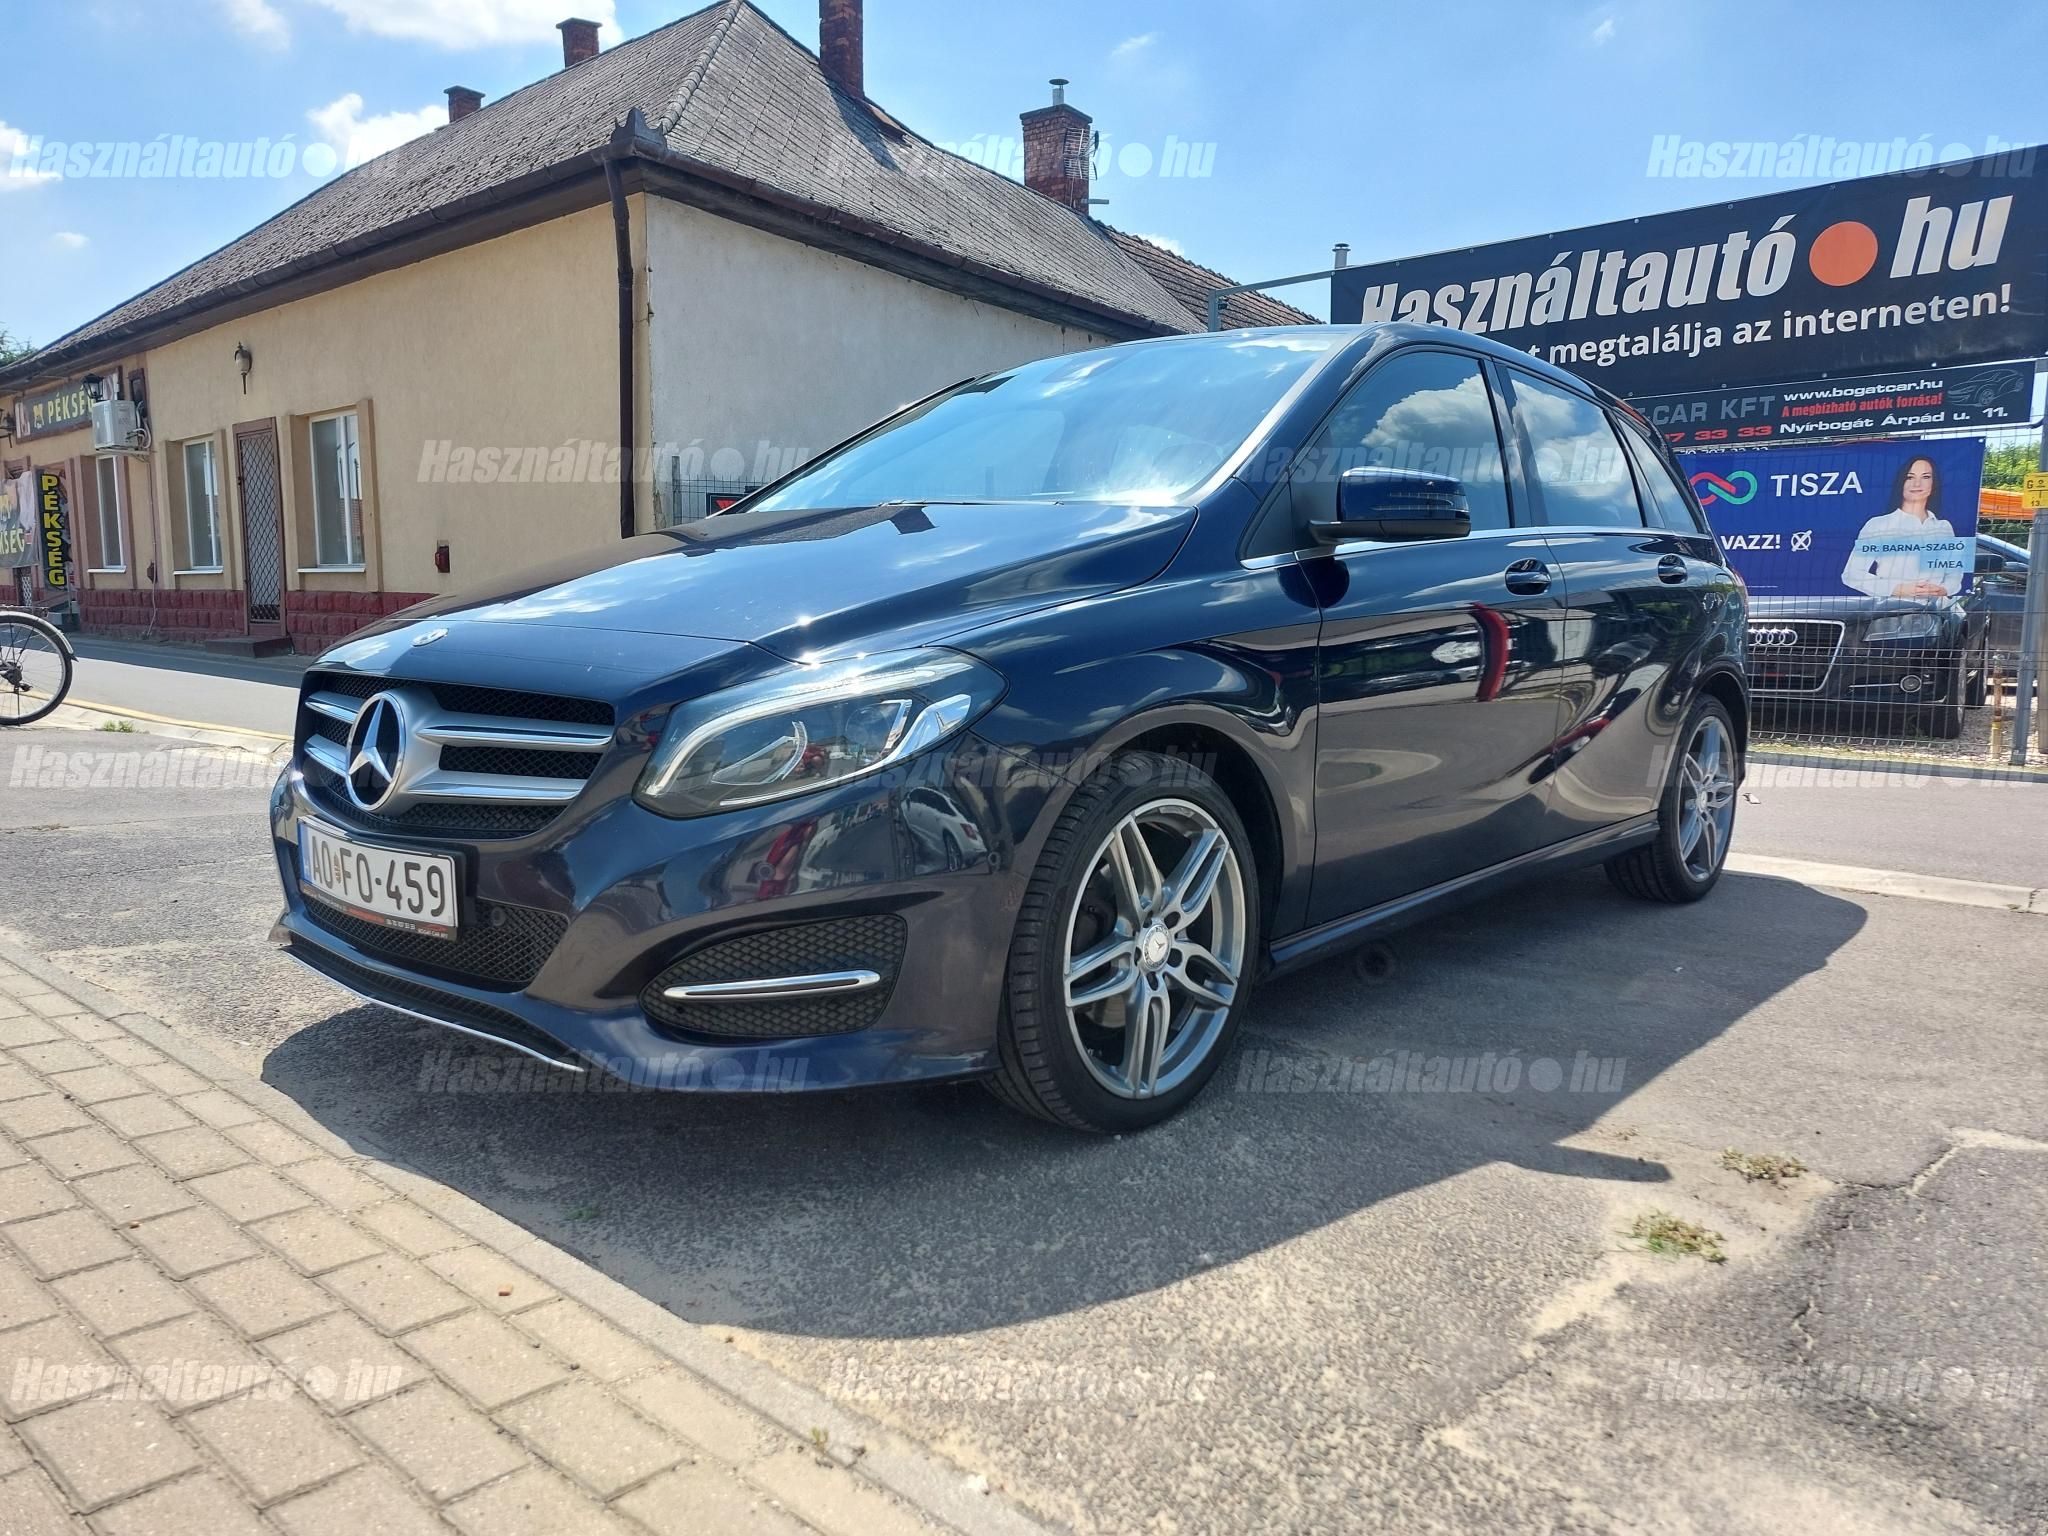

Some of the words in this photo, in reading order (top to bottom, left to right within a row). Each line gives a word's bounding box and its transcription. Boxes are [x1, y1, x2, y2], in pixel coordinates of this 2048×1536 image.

[1550, 320, 1722, 367] megtalálja
[1733, 318, 1772, 345] az
[1784, 283, 2013, 340] interneten!
[1784, 379, 1944, 402] www.bogatcar.hu
[1720, 395, 1775, 420] KFT
[1781, 405, 1790, 418] A
[1791, 399, 1857, 417] megbízható
[1859, 396, 1893, 411] autók
[1896, 392, 1944, 408] forrása!
[1780, 417, 1874, 434] Nyírbogát
[1881, 411, 1945, 427] Árpád
[1953, 411, 1970, 421] u.
[1982, 406, 2009, 418] 11.
[1695, 429, 1728, 441] 33
[1737, 425, 1773, 438] 33
[1770, 471, 1863, 497] TISZA
[41, 474, 67, 587] PÉKSÉG
[1862, 543, 1880, 553] DR.
[1882, 540, 1965, 553] BARNA-SZABÓ
[1927, 558, 1963, 569] TÍMEA
